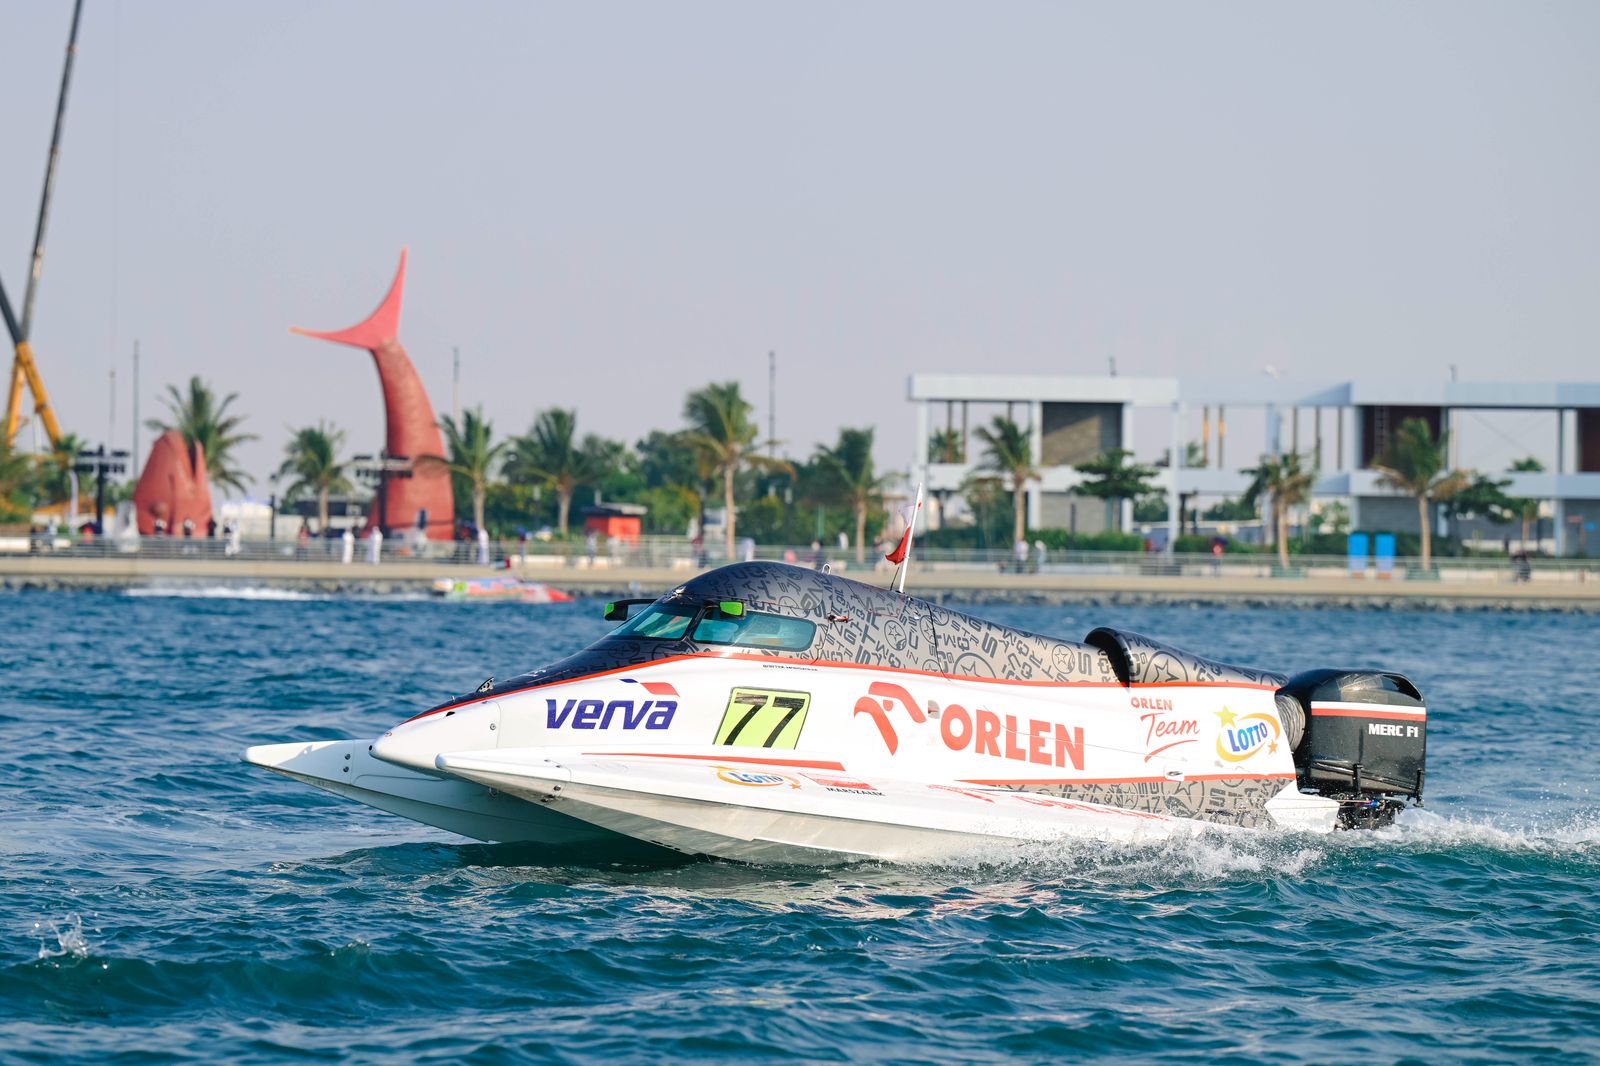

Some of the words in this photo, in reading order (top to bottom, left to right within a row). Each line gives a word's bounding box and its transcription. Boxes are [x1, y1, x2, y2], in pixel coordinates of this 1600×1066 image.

[1130, 696, 1173, 711] ORLEN
[723, 692, 806, 749] 77
[1140, 713, 1201, 747] Team
[1227, 721, 1269, 752] LOTTO
[1368, 723, 1404, 737] MERC
[1406, 725, 1419, 738] F1
[940, 703, 1085, 771] ORLEN
